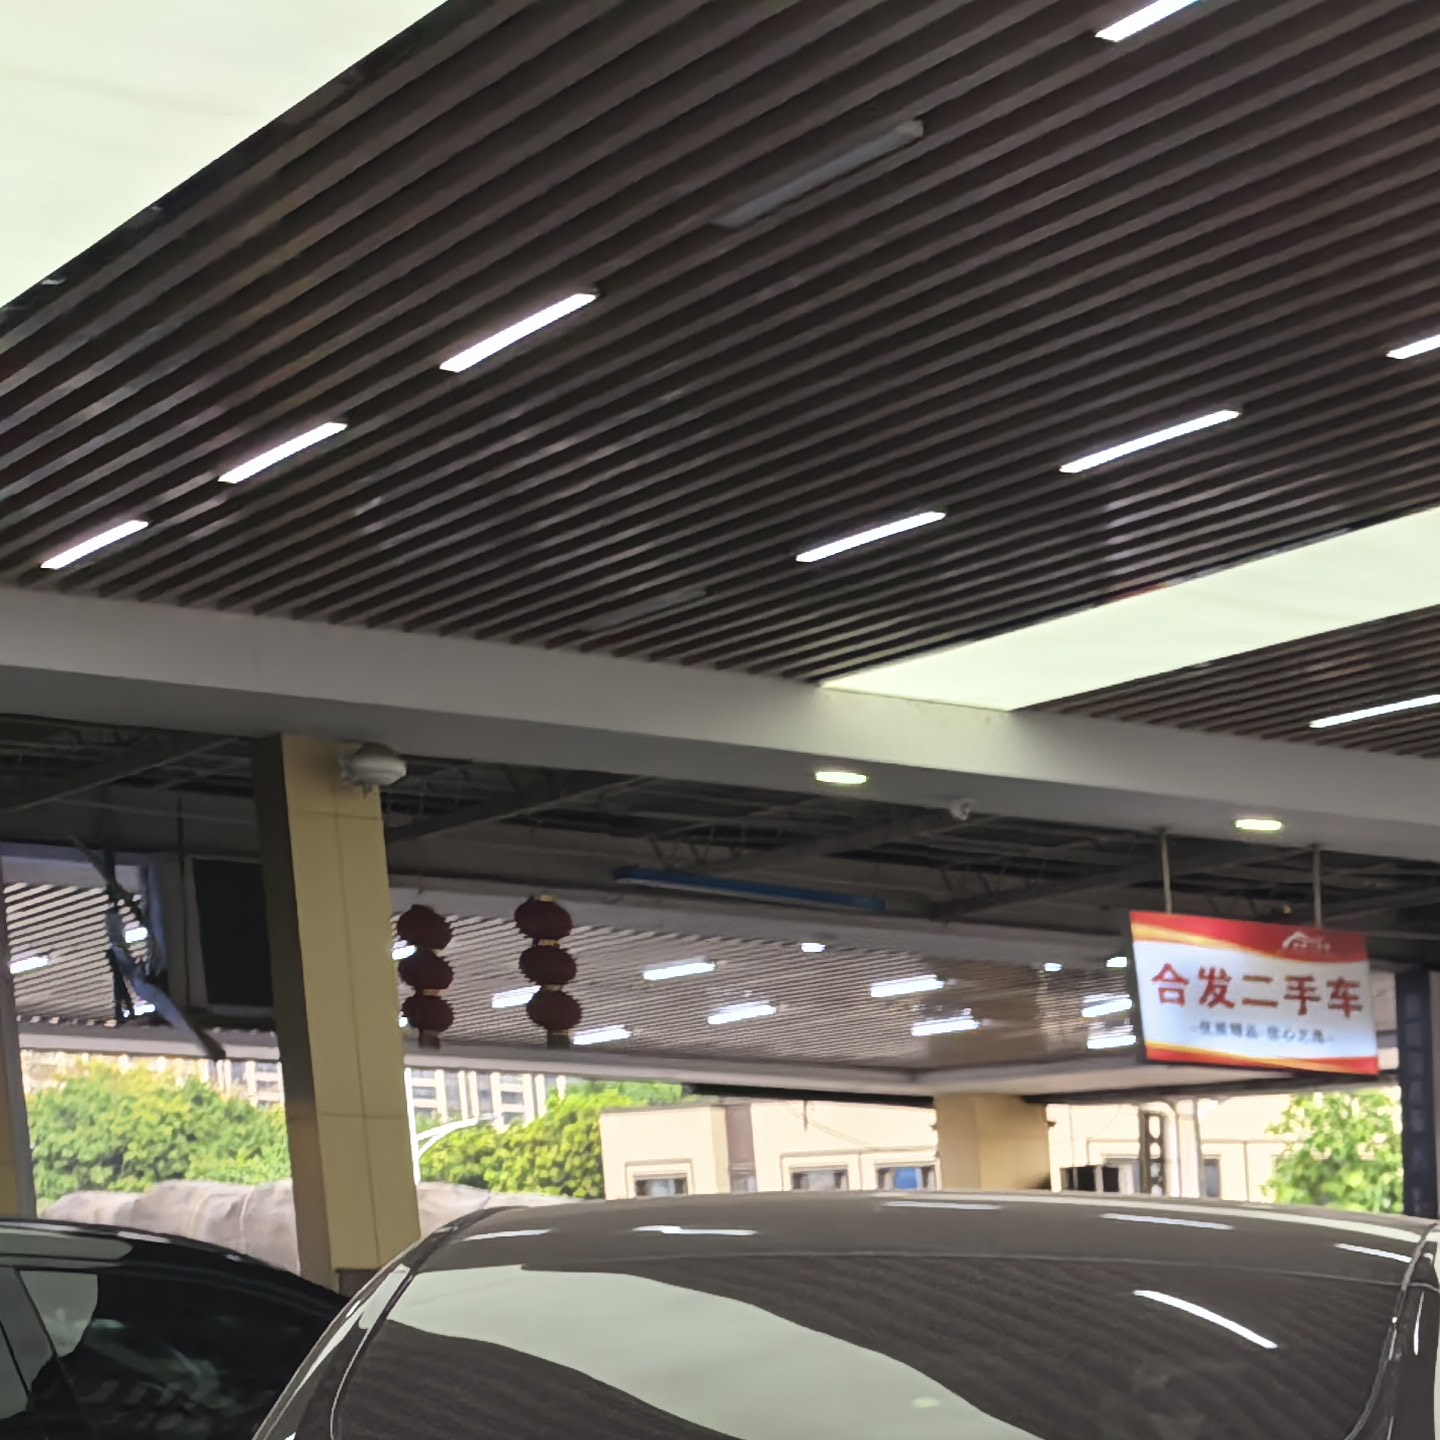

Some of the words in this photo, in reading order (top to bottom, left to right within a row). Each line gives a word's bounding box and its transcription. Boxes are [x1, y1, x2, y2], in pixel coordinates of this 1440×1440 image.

[1152, 963, 1363, 1017] 合发二手车
